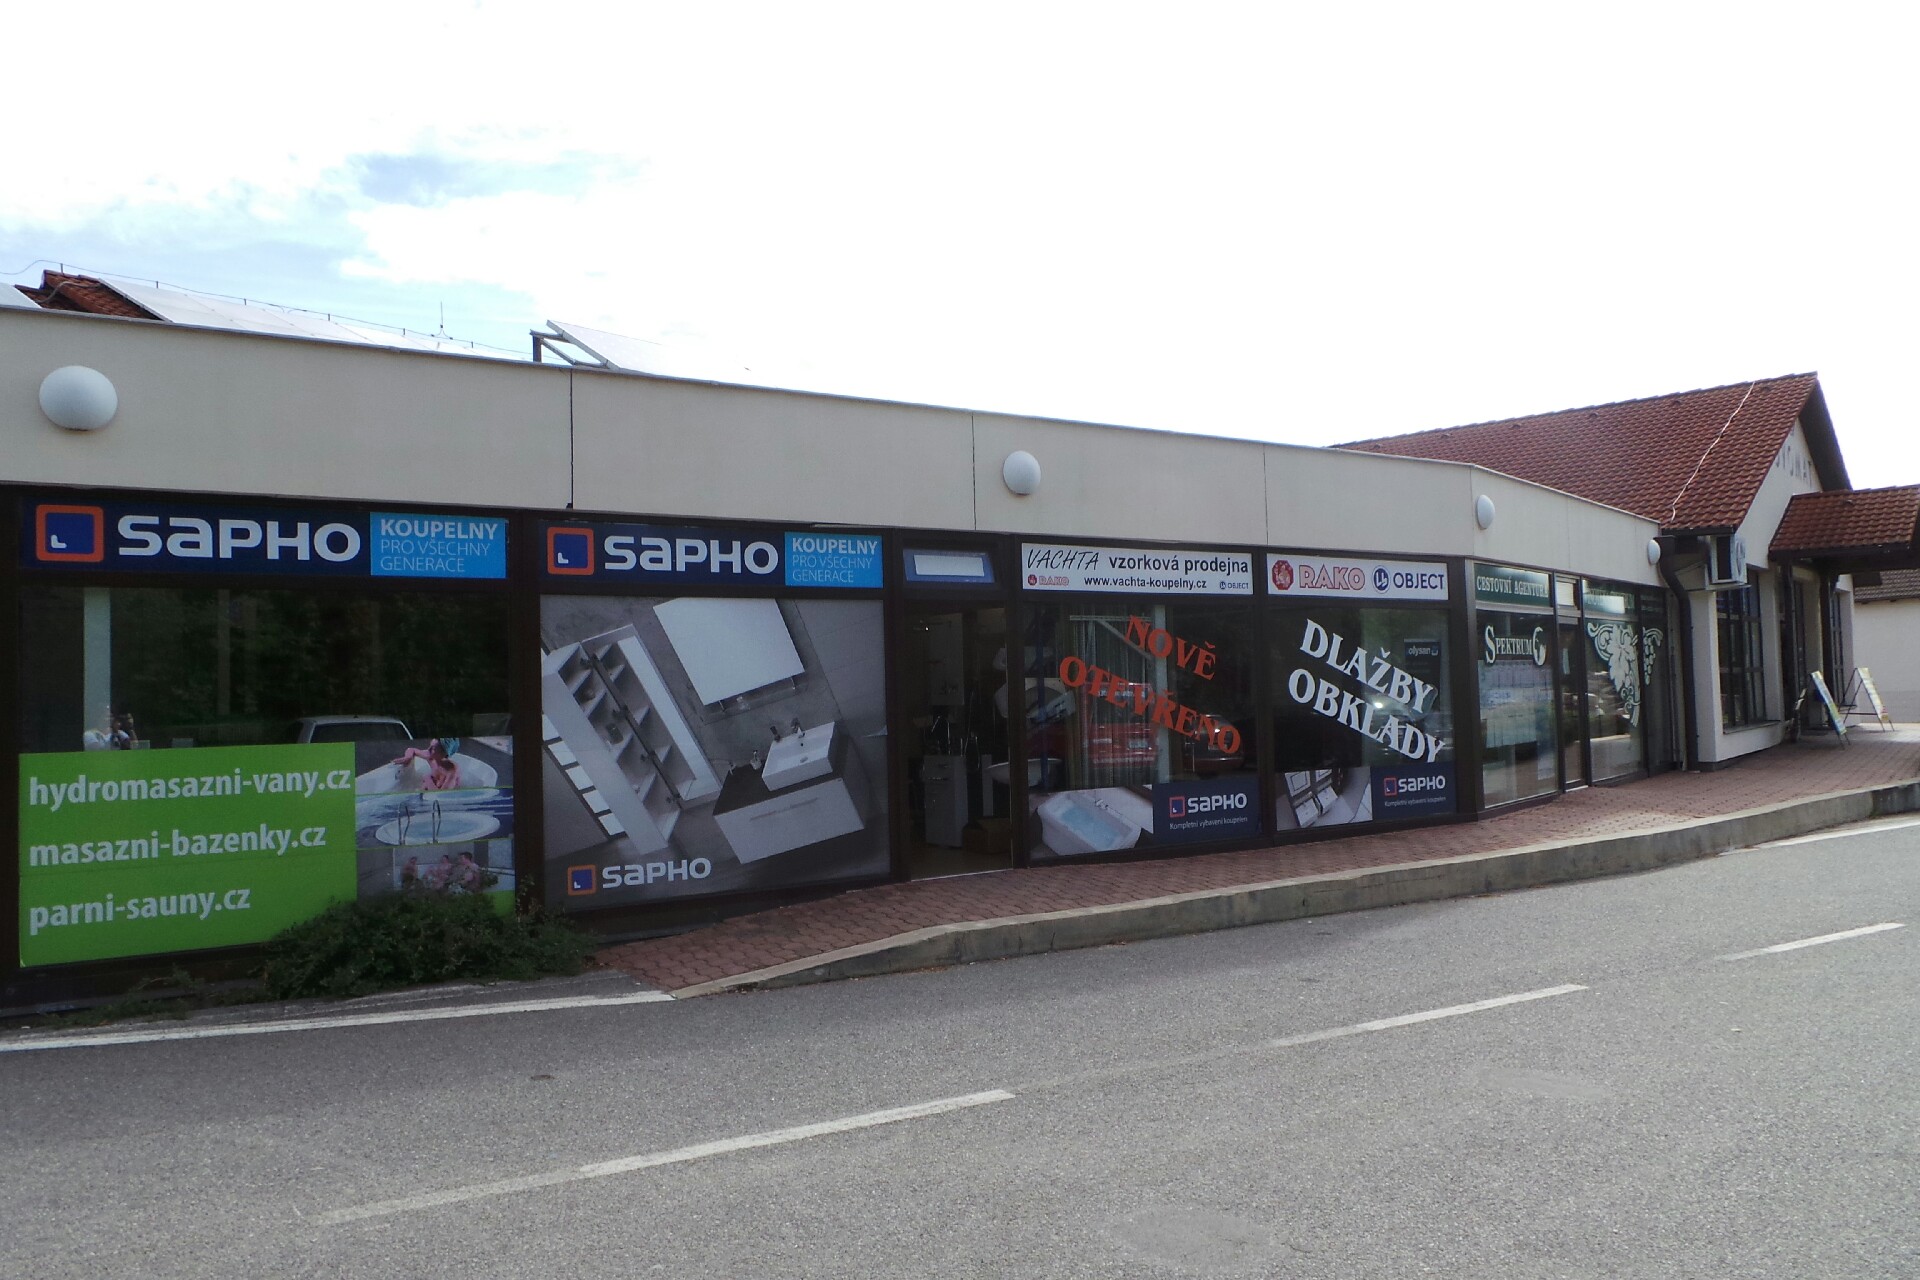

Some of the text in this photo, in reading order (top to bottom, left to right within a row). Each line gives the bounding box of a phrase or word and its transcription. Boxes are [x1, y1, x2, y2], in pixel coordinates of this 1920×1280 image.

[380, 518, 498, 540] KOUPELNY
[381, 538, 490, 556] PRO VŠECHNY
[792, 537, 878, 556] KOUPELNY
[380, 556, 466, 573] GENERACE
[792, 553, 873, 569] PRO VŠECHNY
[1027, 549, 1249, 577] VACHTA vzorková prodejna
[792, 569, 855, 583] GENERACE
[1038, 575, 1249, 590] RAKO www.vachta-koupelny.cz OBJECT
[1298, 564, 1445, 591] RAKO OBJECT
[1476, 576, 1549, 598] CESTOVNÍ AGENTURA
[1124, 614, 1217, 681] NOVĚ
[1299, 618, 1434, 714] DLAŽBY
[1059, 655, 1242, 755] OTEVŘENO
[1288, 668, 1446, 763] OBKLADY
[29, 767, 351, 812] hydromasazni-vany.cz
[29, 823, 327, 867] masazni-bazenky.cz
[29, 889, 251, 936] parni-sauny.cz
